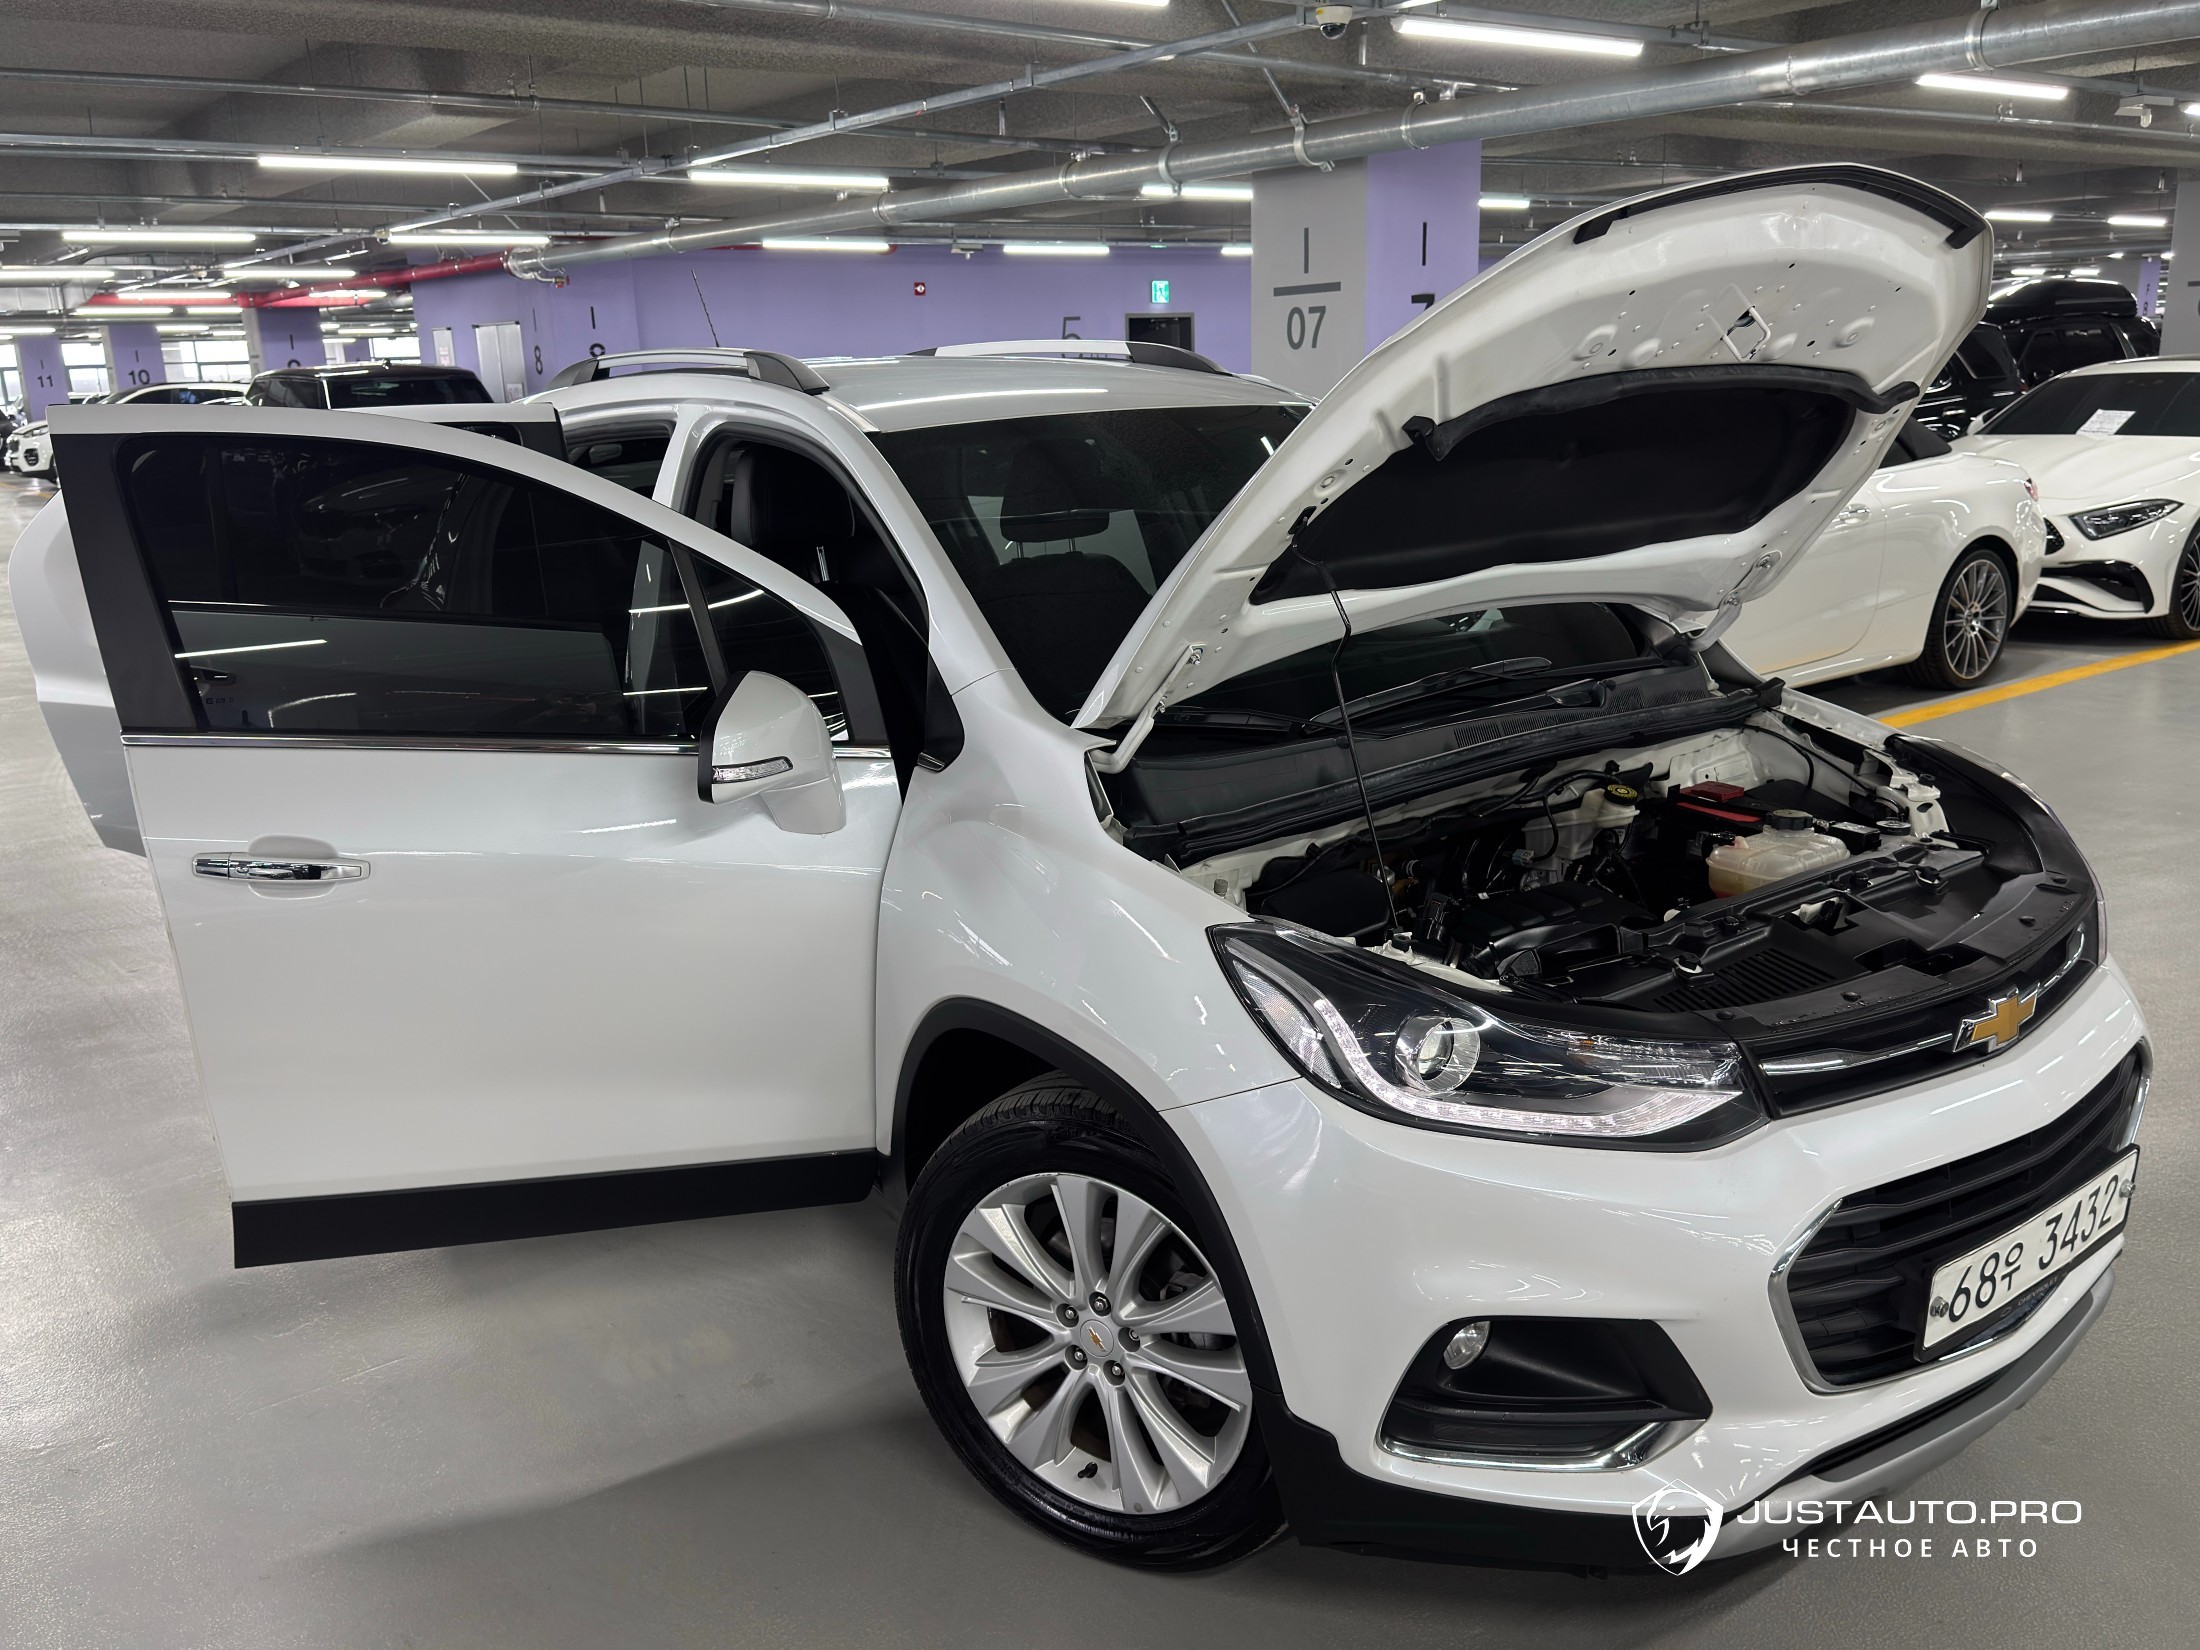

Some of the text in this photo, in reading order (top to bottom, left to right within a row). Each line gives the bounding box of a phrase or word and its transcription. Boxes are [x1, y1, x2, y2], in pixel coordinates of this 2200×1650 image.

[1286, 305, 1327, 350] 07
[534, 344, 544, 376] 8
[37, 374, 54, 388] 11
[128, 369, 151, 385] 10
[1948, 1174, 2120, 1323] 68우 3432
